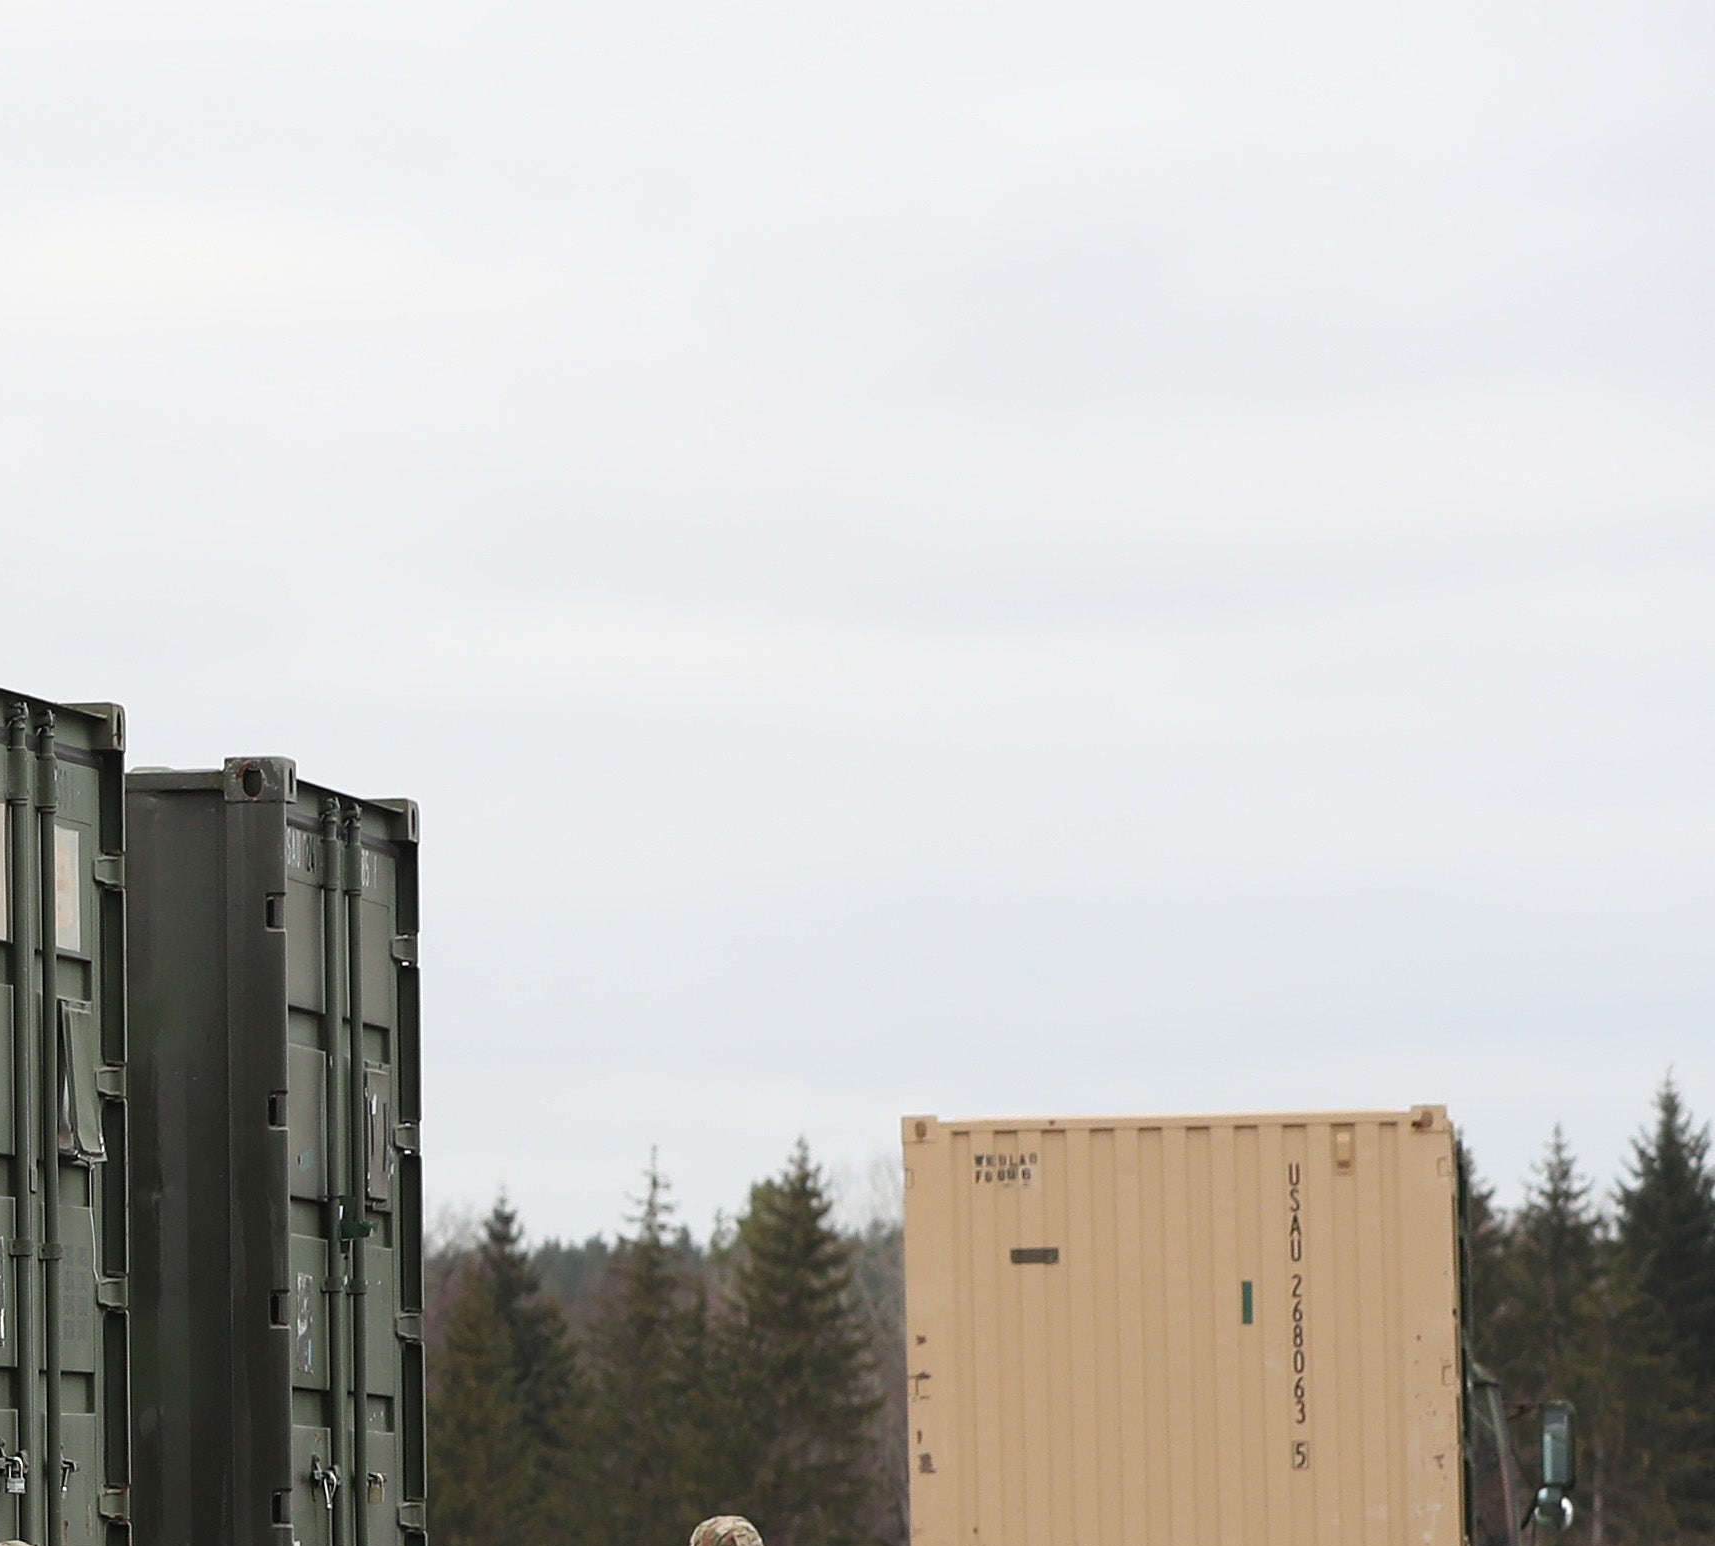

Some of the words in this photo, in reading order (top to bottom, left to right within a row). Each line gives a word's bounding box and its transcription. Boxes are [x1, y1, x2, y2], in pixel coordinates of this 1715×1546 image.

[1288, 1162, 1302, 1262] USAU
[1291, 1274, 1306, 1425] 268063
[1296, 1443, 1306, 1469] 5
